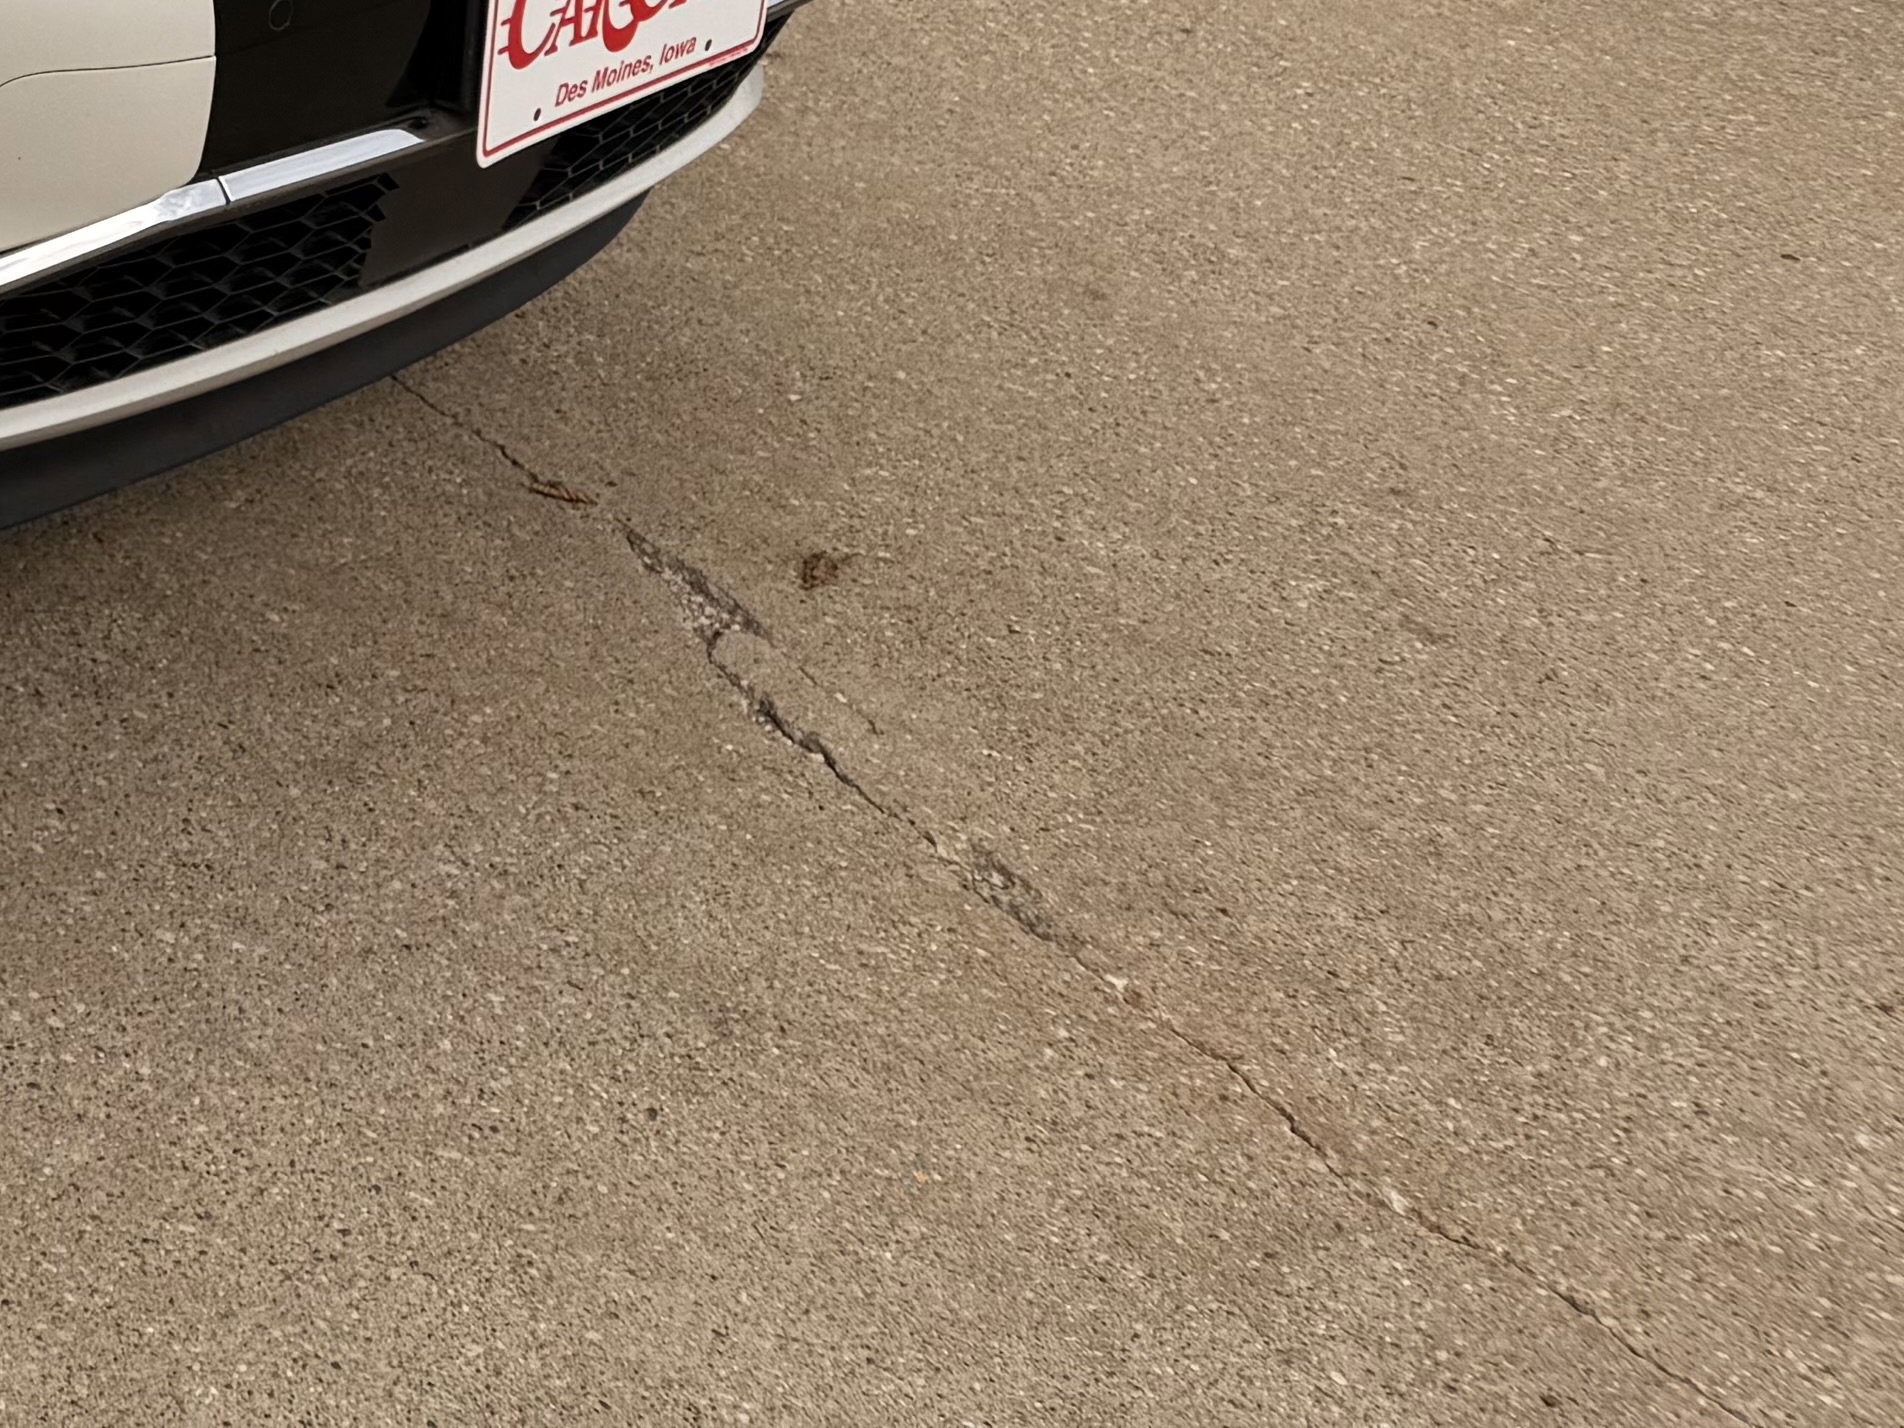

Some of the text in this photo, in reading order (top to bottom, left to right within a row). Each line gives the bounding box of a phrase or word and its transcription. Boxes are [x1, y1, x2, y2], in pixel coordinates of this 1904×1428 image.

[554, 80, 587, 108] Des
[592, 54, 654, 91] Moines,
[659, 34, 698, 64] Iowa
